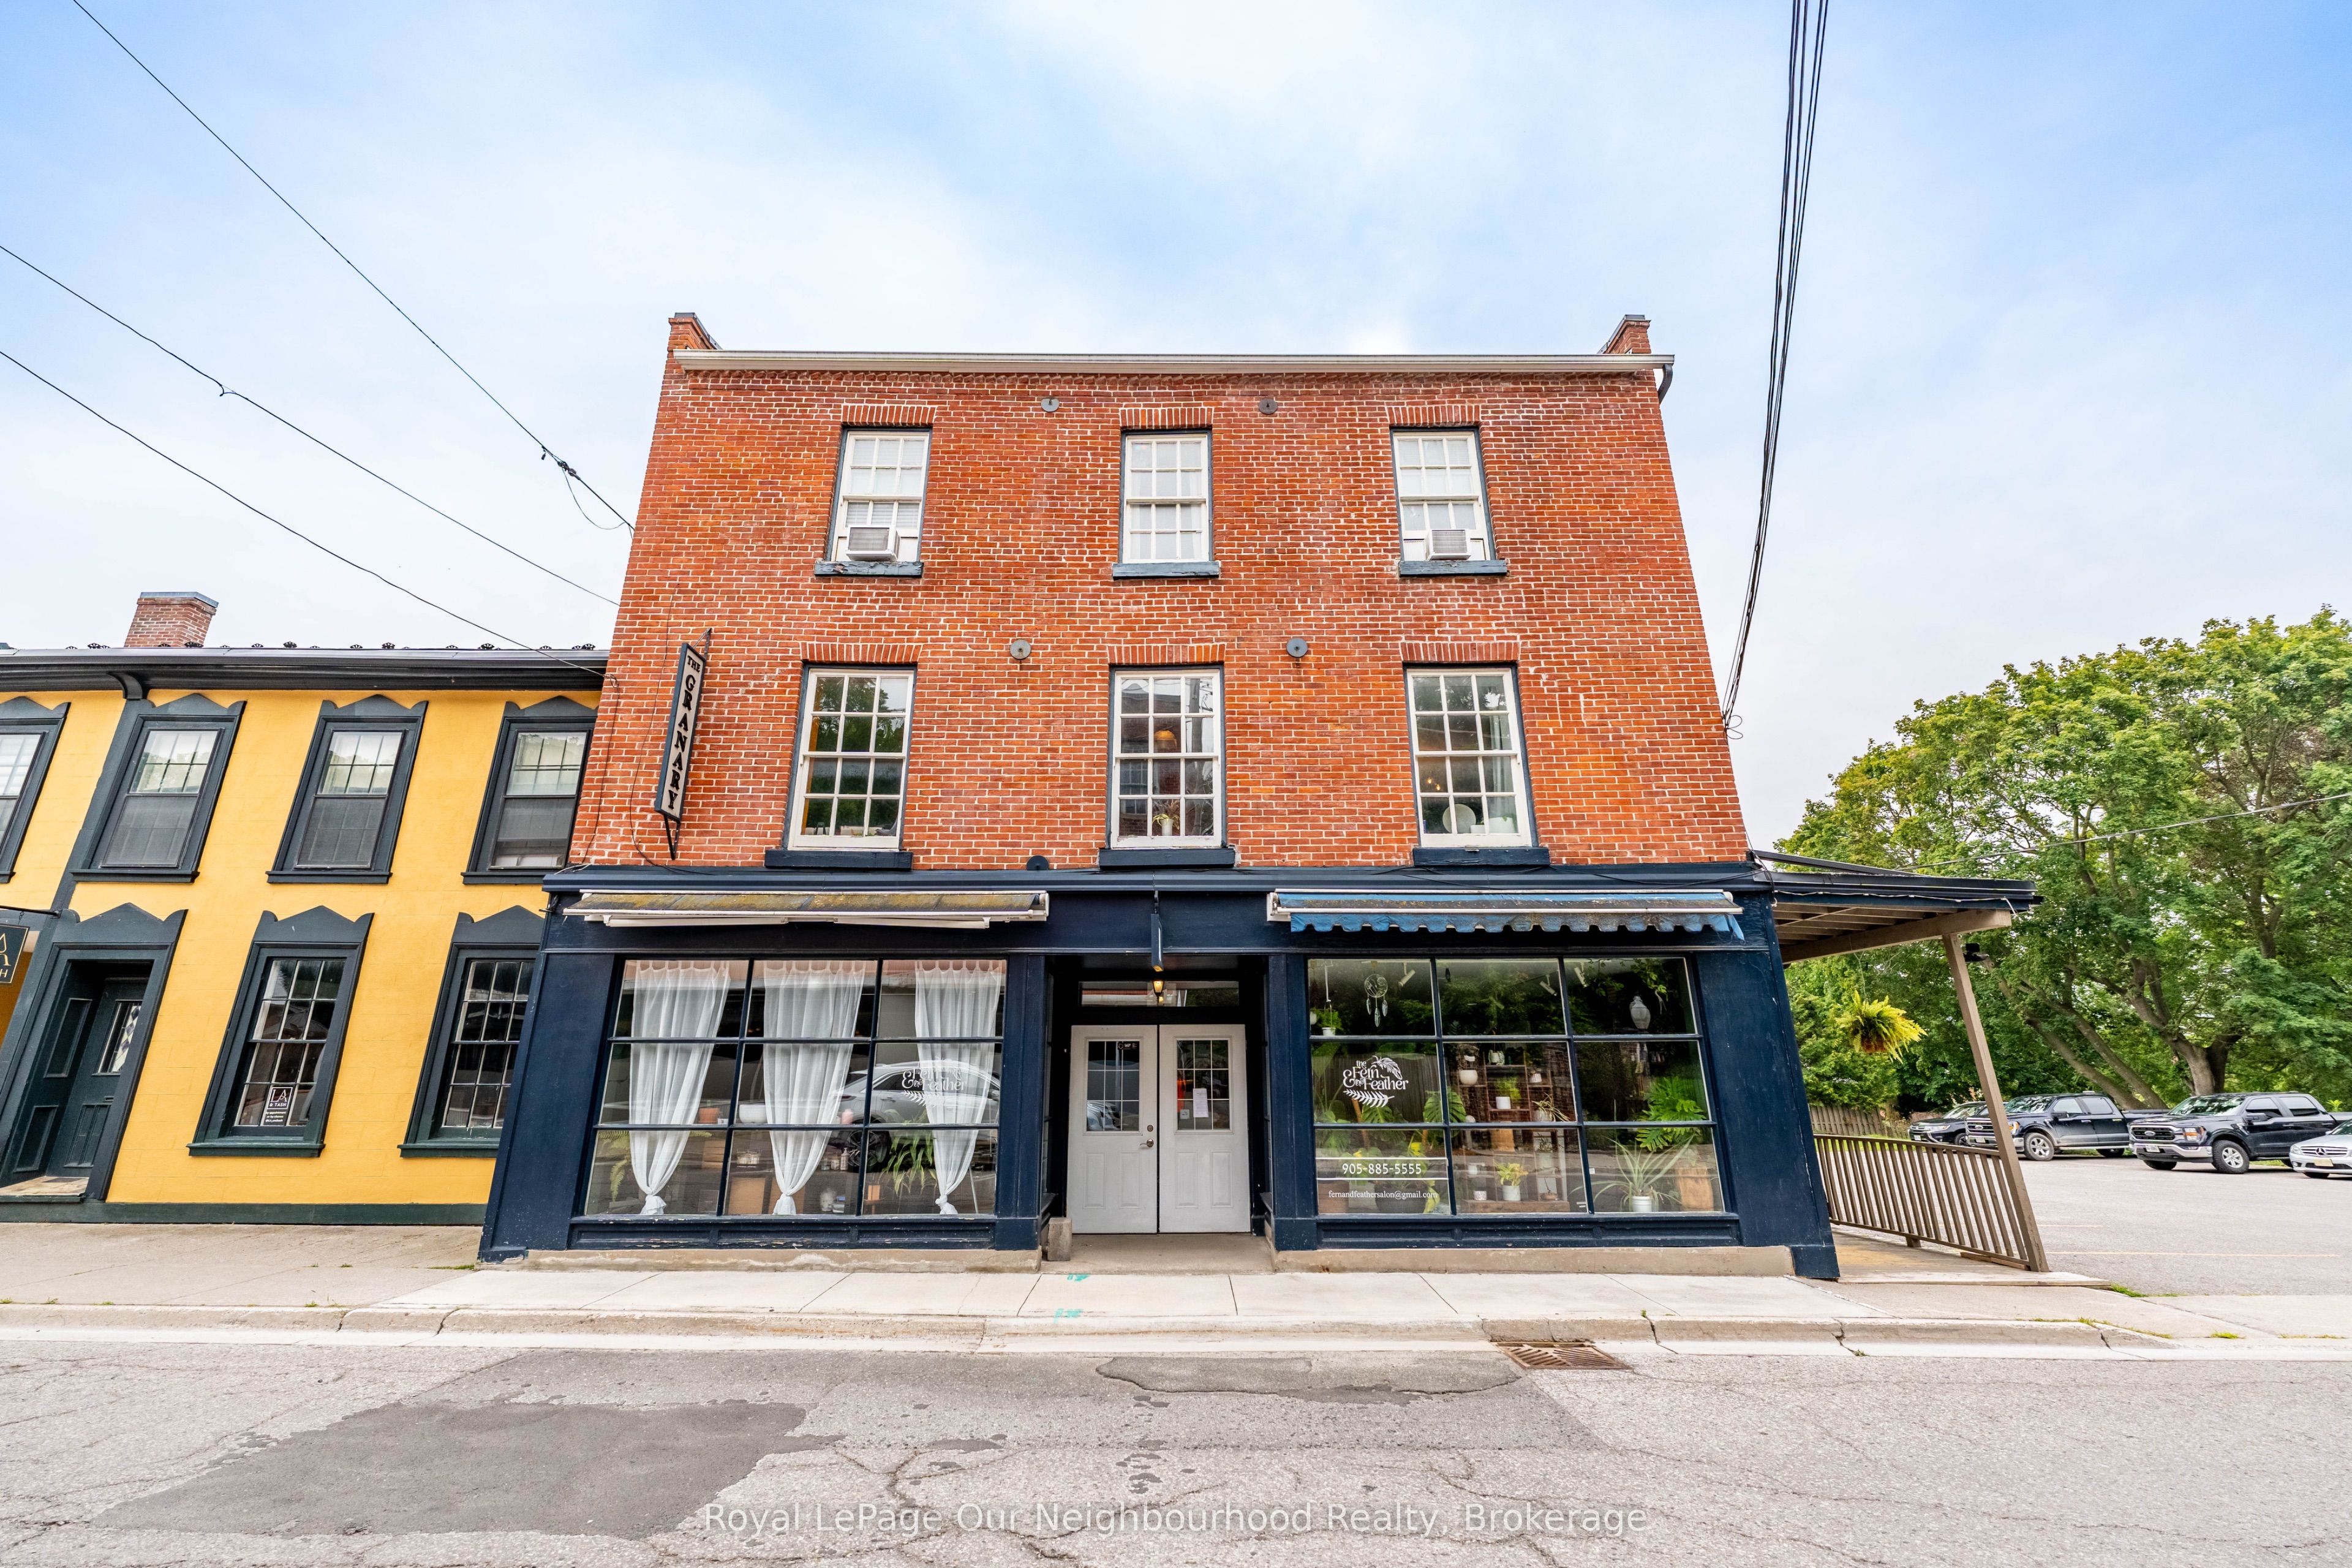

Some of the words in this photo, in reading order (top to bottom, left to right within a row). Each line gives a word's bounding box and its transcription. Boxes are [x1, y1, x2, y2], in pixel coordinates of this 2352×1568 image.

[687, 655, 701, 673] THE
[668, 674, 696, 810] GRANARY
[1356, 1060, 1366, 1069] the
[902, 1069, 914, 1088] &
[1343, 1069, 1355, 1088] &
[1363, 1074, 1409, 1090] Feather
[270, 1089, 288, 1102] LA
[1342, 1163, 1422, 1174] 905-885-5555
[1329, 1190, 1438, 1200] fernandfeathersalon@gmail.com
